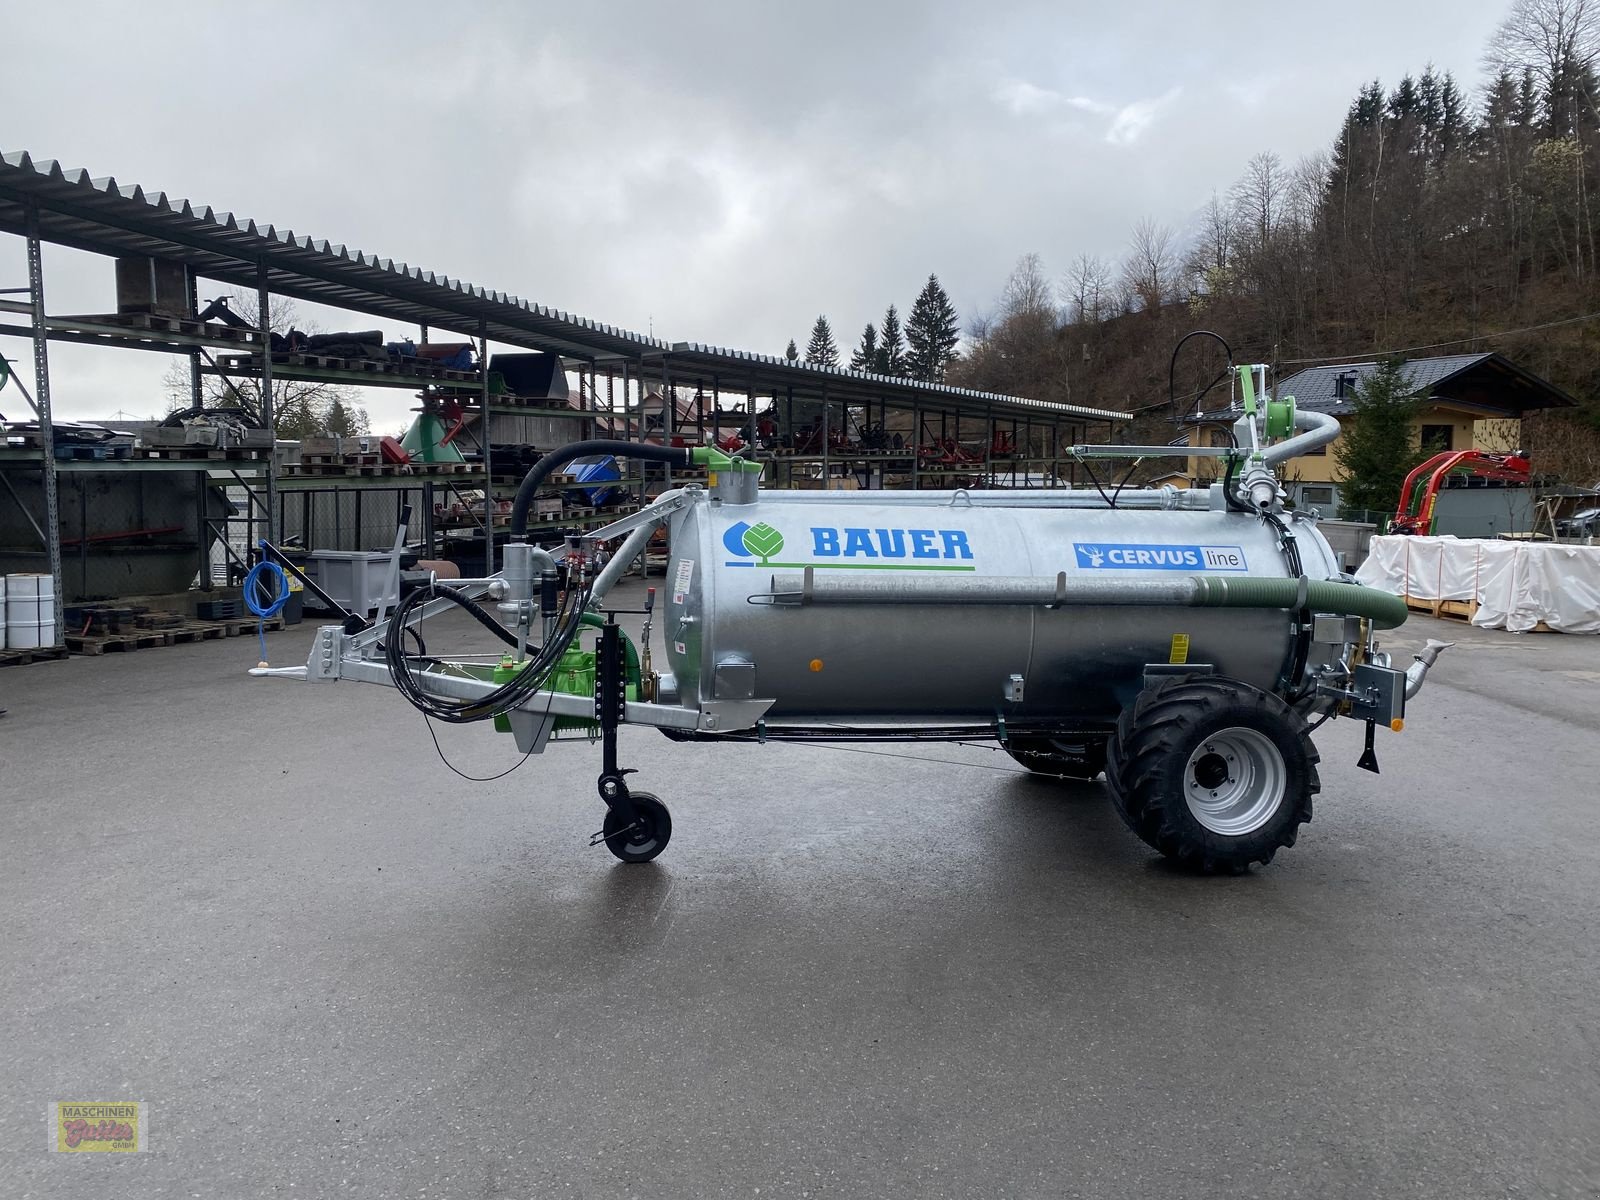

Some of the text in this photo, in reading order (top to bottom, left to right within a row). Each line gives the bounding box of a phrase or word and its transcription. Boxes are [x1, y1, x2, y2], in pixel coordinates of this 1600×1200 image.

[810, 527, 974, 559] BAUER
[1108, 549, 1240, 567] CERVUS line
